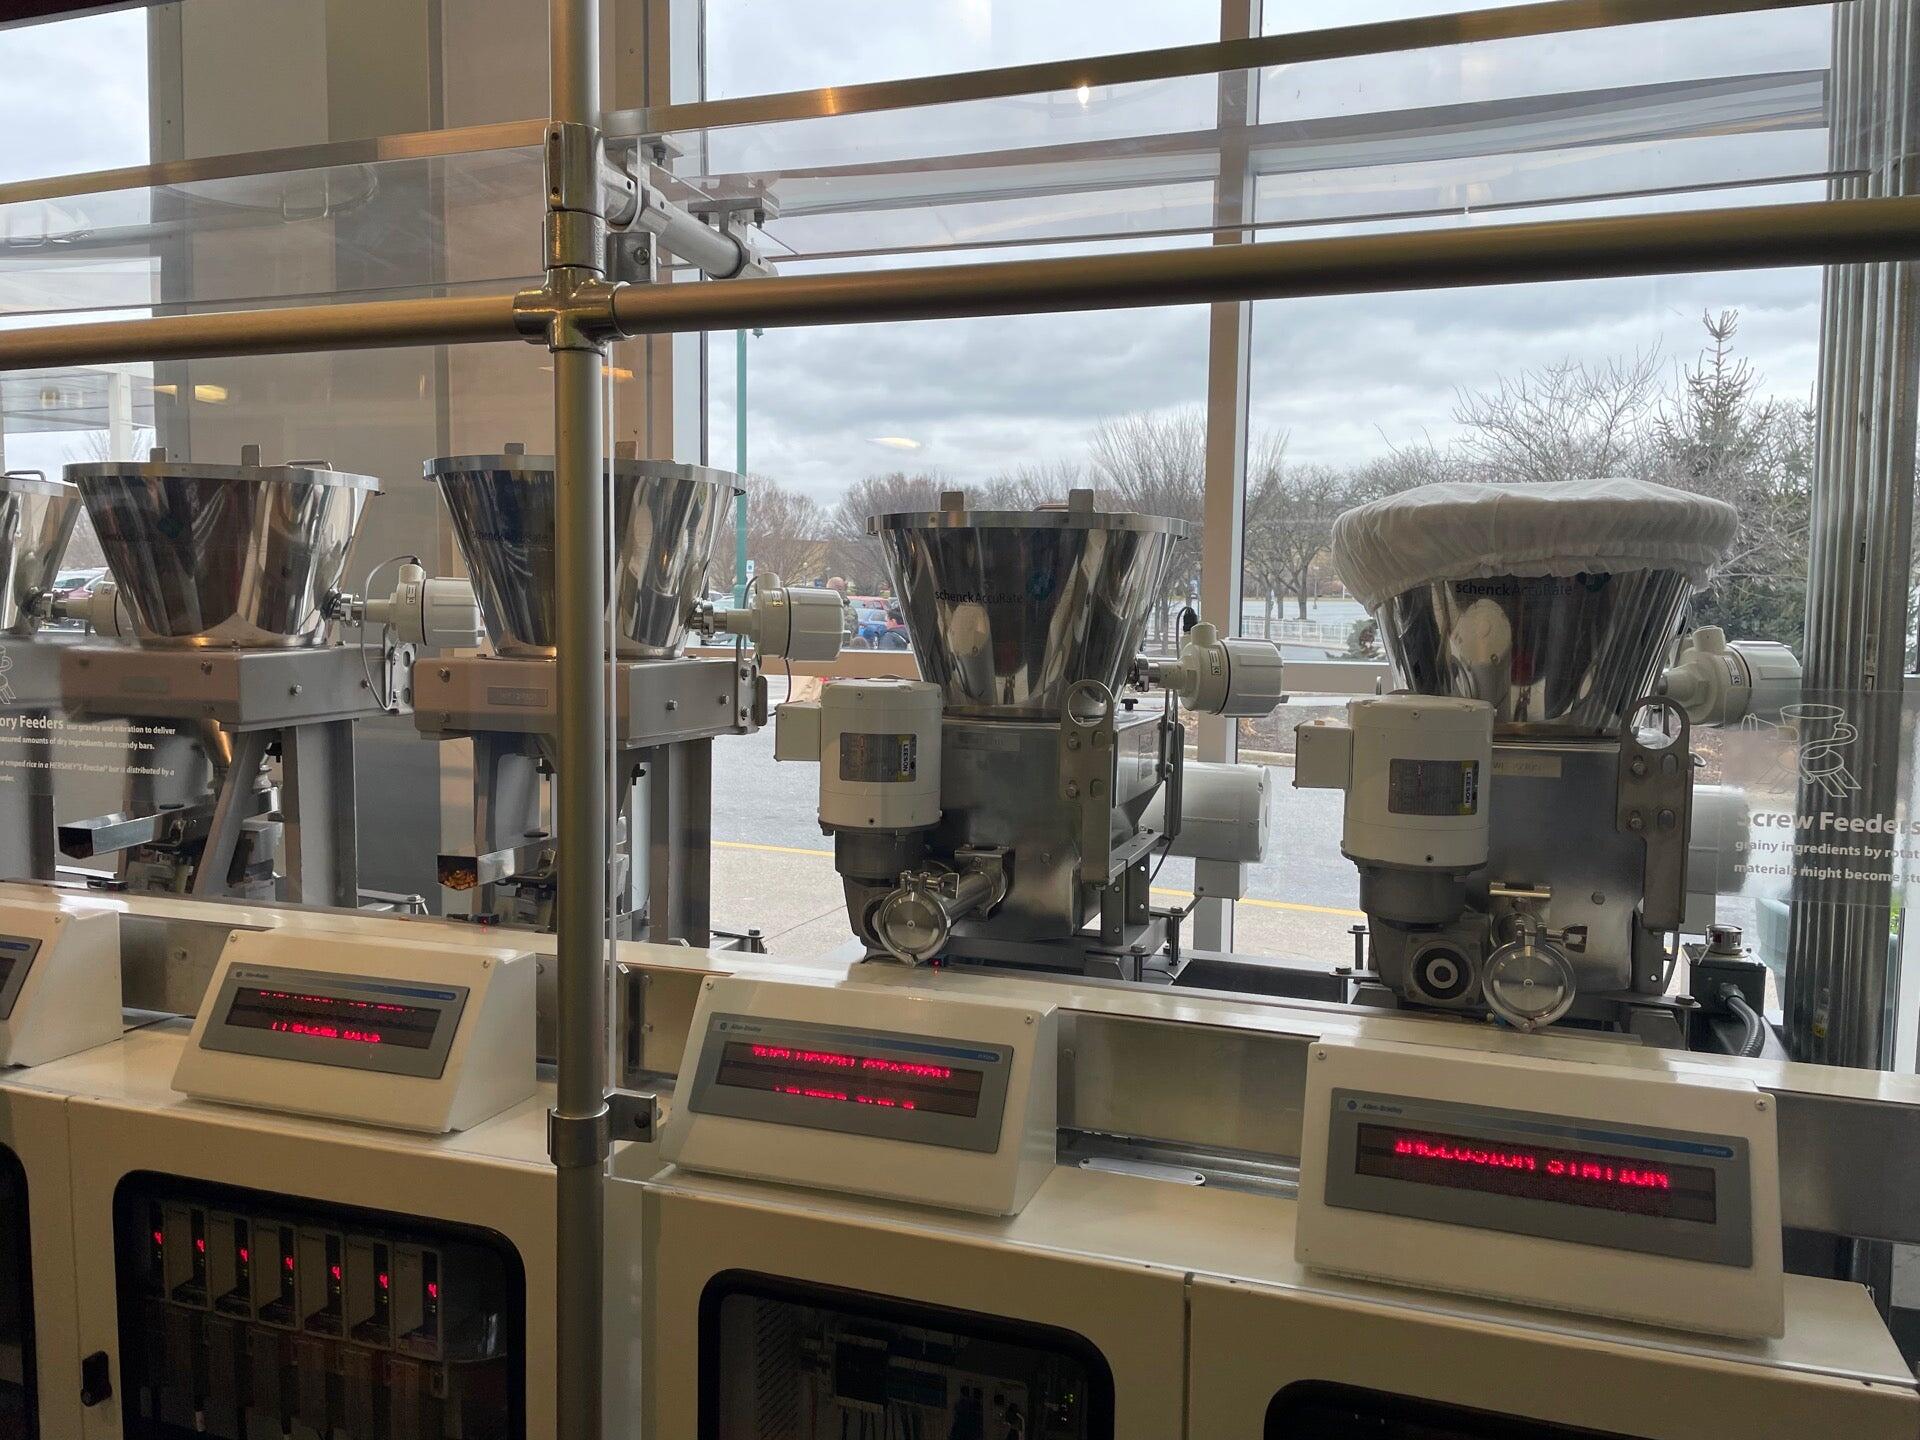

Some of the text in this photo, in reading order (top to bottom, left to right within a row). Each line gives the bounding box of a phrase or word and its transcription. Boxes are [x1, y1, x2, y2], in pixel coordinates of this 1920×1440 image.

[20, 715, 64, 730] Feeders
[153, 726, 175, 735] deliver
[139, 741, 155, 750] bars.
[126, 765, 160, 775] distributed
[162, 767, 169, 777] by
[1820, 812, 1920, 835] Feeders
[1782, 842, 1860, 857] ingredients
[1864, 845, 1882, 860] by
[1734, 864, 1798, 876] materials
[1800, 866, 1842, 880] might
[1845, 867, 1900, 883] become
